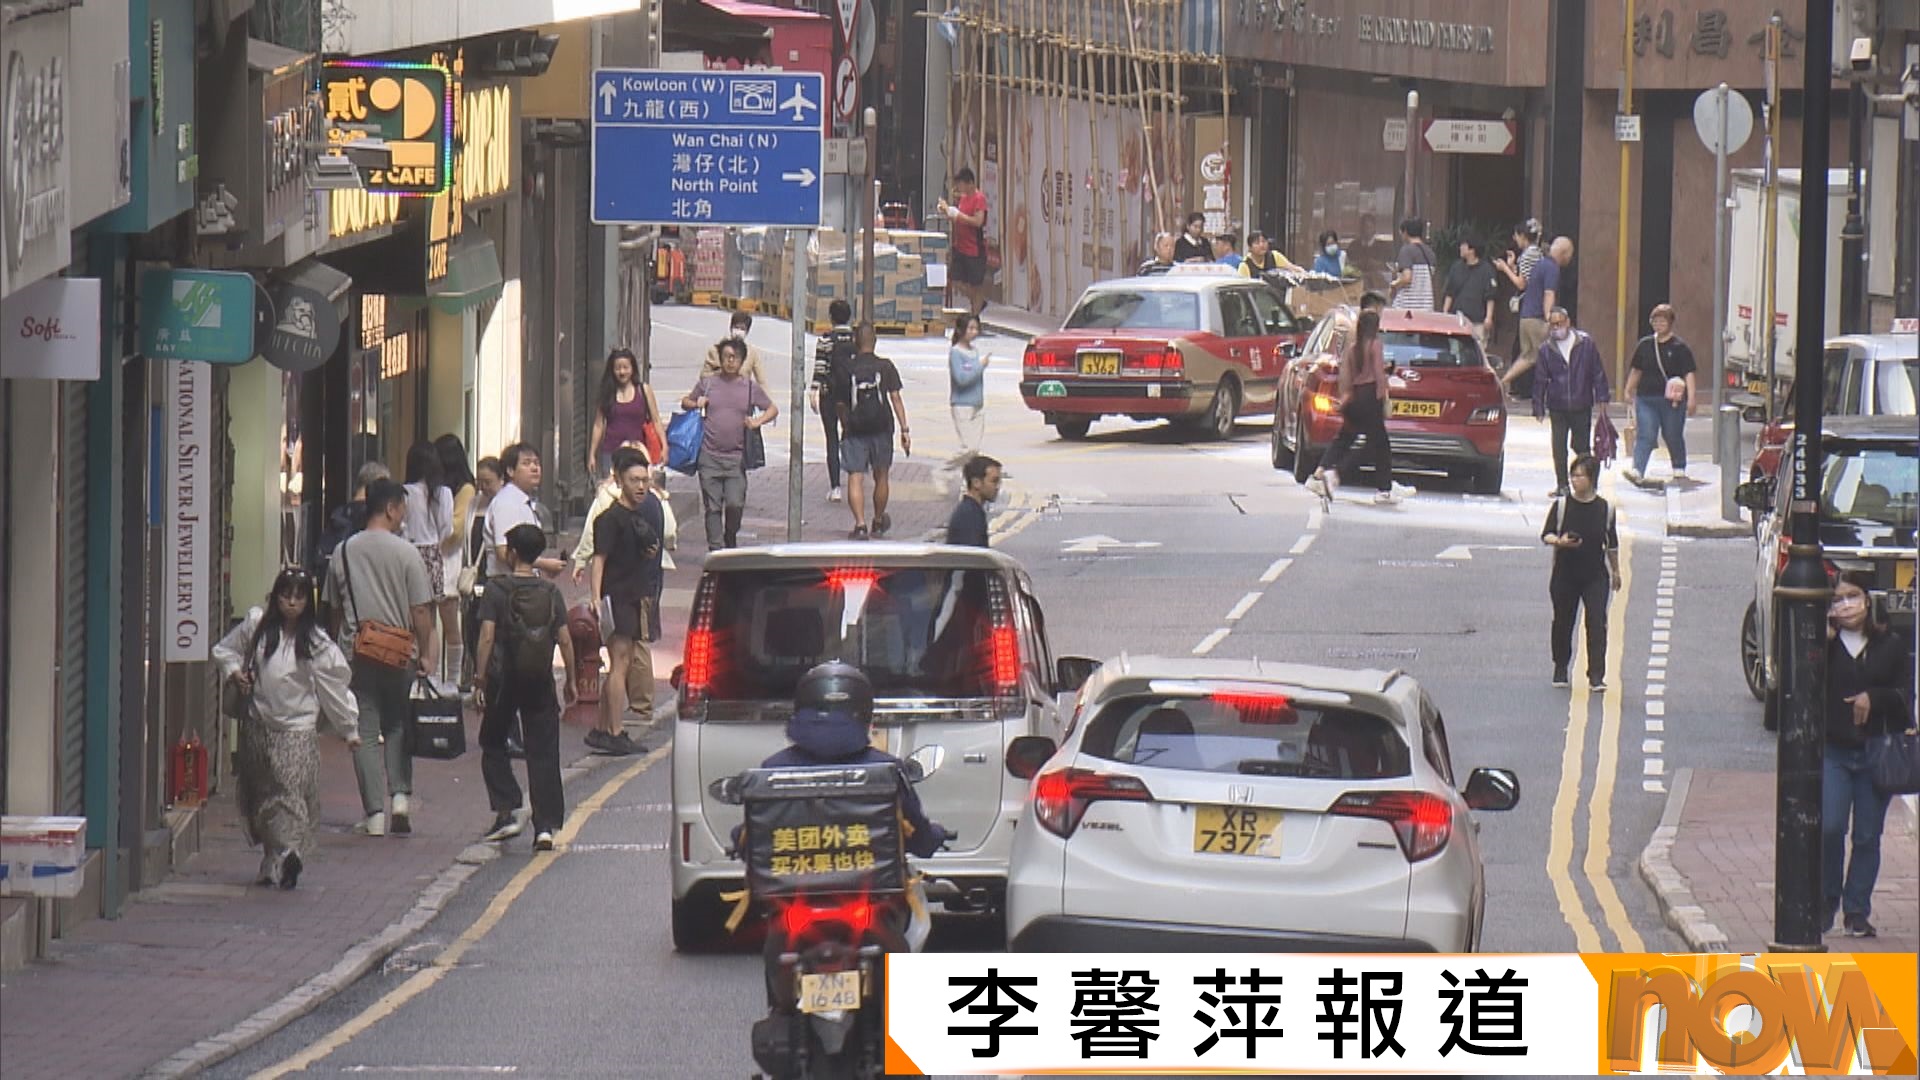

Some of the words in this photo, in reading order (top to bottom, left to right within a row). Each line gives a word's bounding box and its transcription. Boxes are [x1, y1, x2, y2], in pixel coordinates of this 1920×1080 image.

[622, 77, 687, 93] Kowloon
[672, 133, 705, 148] Wan
[709, 133, 744, 148] Chai
[386, 167, 436, 186] CAFE
[671, 178, 714, 193] North
[719, 179, 759, 194] Point
[671, 198, 712, 219] 北角
[1403, 403, 1437, 416] 2895
[177, 444, 200, 507] SILVER
[1795, 433, 1808, 500] 24633
[177, 511, 200, 615] JEWELLERY
[1221, 806, 1258, 833] XR
[772, 823, 872, 852] 美团外卖
[770, 850, 875, 877] 买水果也快
